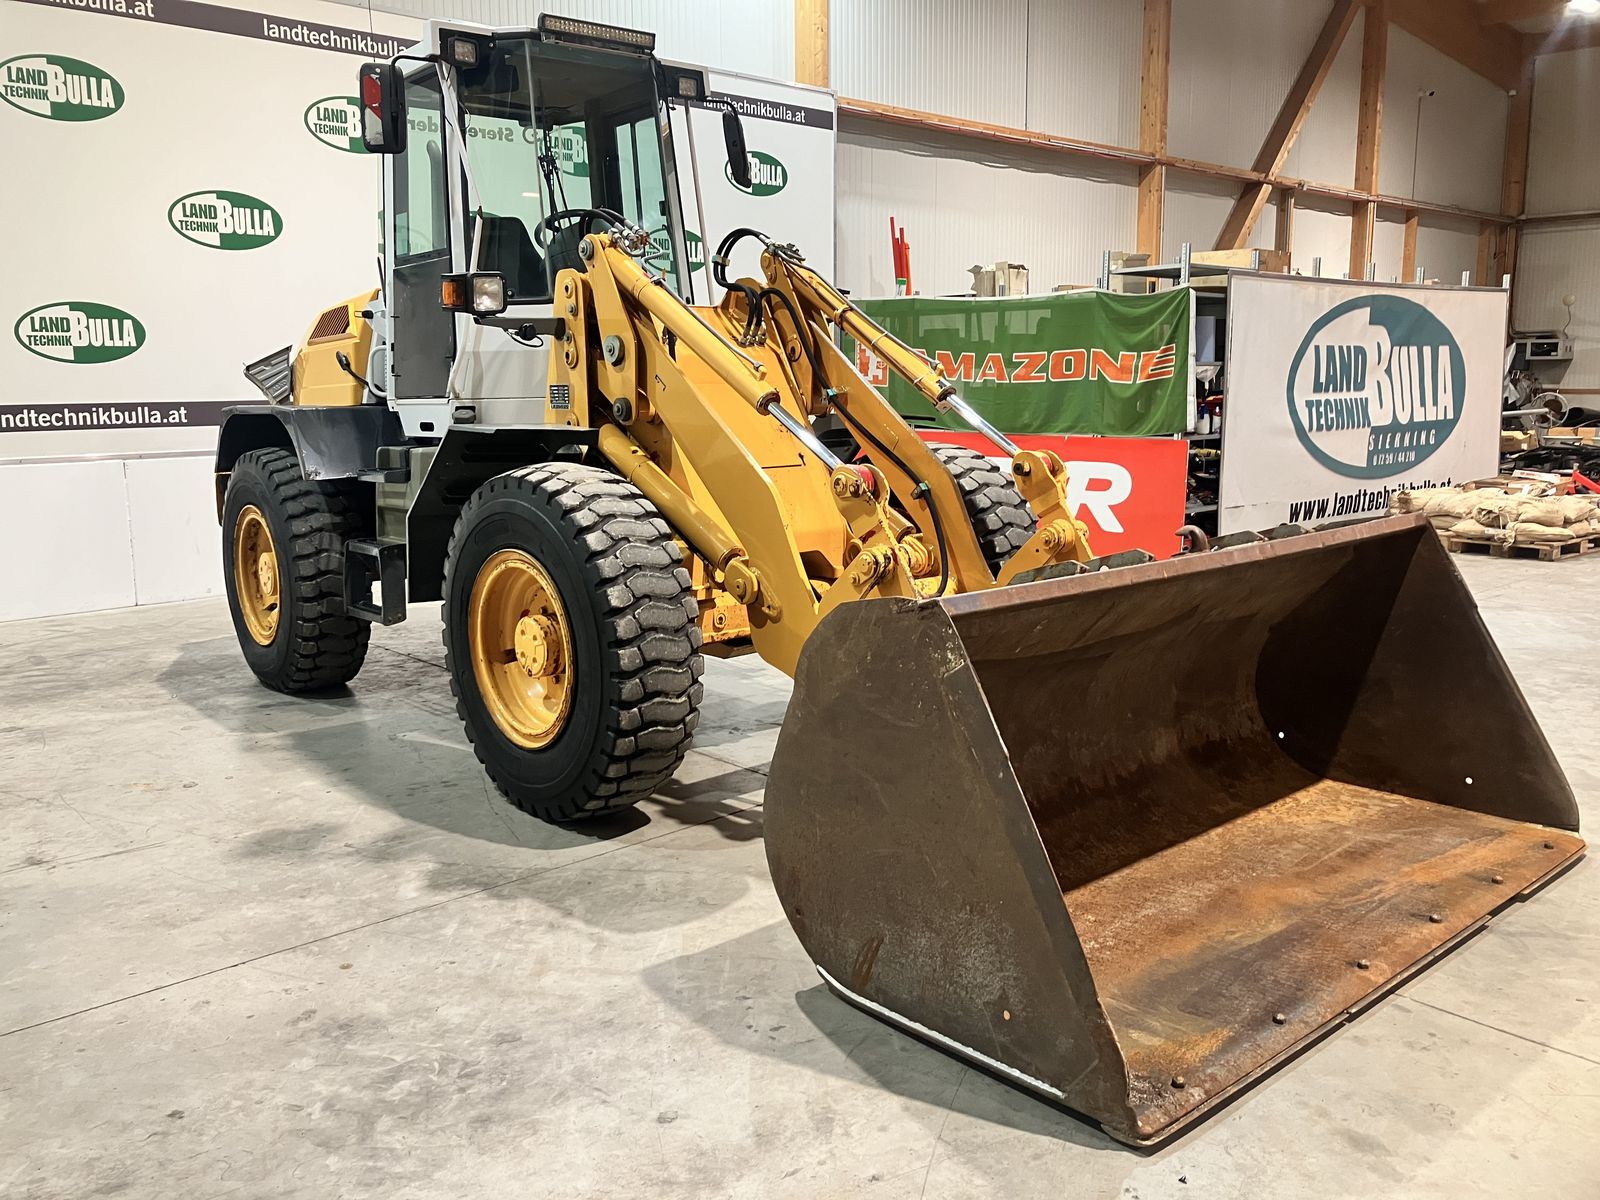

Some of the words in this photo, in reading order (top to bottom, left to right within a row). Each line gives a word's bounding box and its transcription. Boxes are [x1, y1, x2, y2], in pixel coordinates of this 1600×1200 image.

[6, 66, 48, 87] LAND
[48, 63, 116, 109] BULLA
[2, 85, 50, 101] TECHNIK
[316, 106, 348, 124] LAND
[313, 122, 349, 137] TECHNIK
[750, 157, 784, 187] BULLA
[181, 202, 218, 220] LAND
[217, 199, 275, 237] BULLA
[178, 219, 220, 233] TECHNIK
[30, 316, 71, 333] LAND
[69, 310, 137, 347] BULLA
[26, 334, 73, 347] TECHNIK
[1313, 344, 1368, 394] LAND
[1369, 324, 1454, 427] BULLA
[1, 406, 188, 428] ndtechnikbulla.at
[1305, 397, 1372, 433] TECHNIK
[1368, 429, 1436, 451] SIERNING
